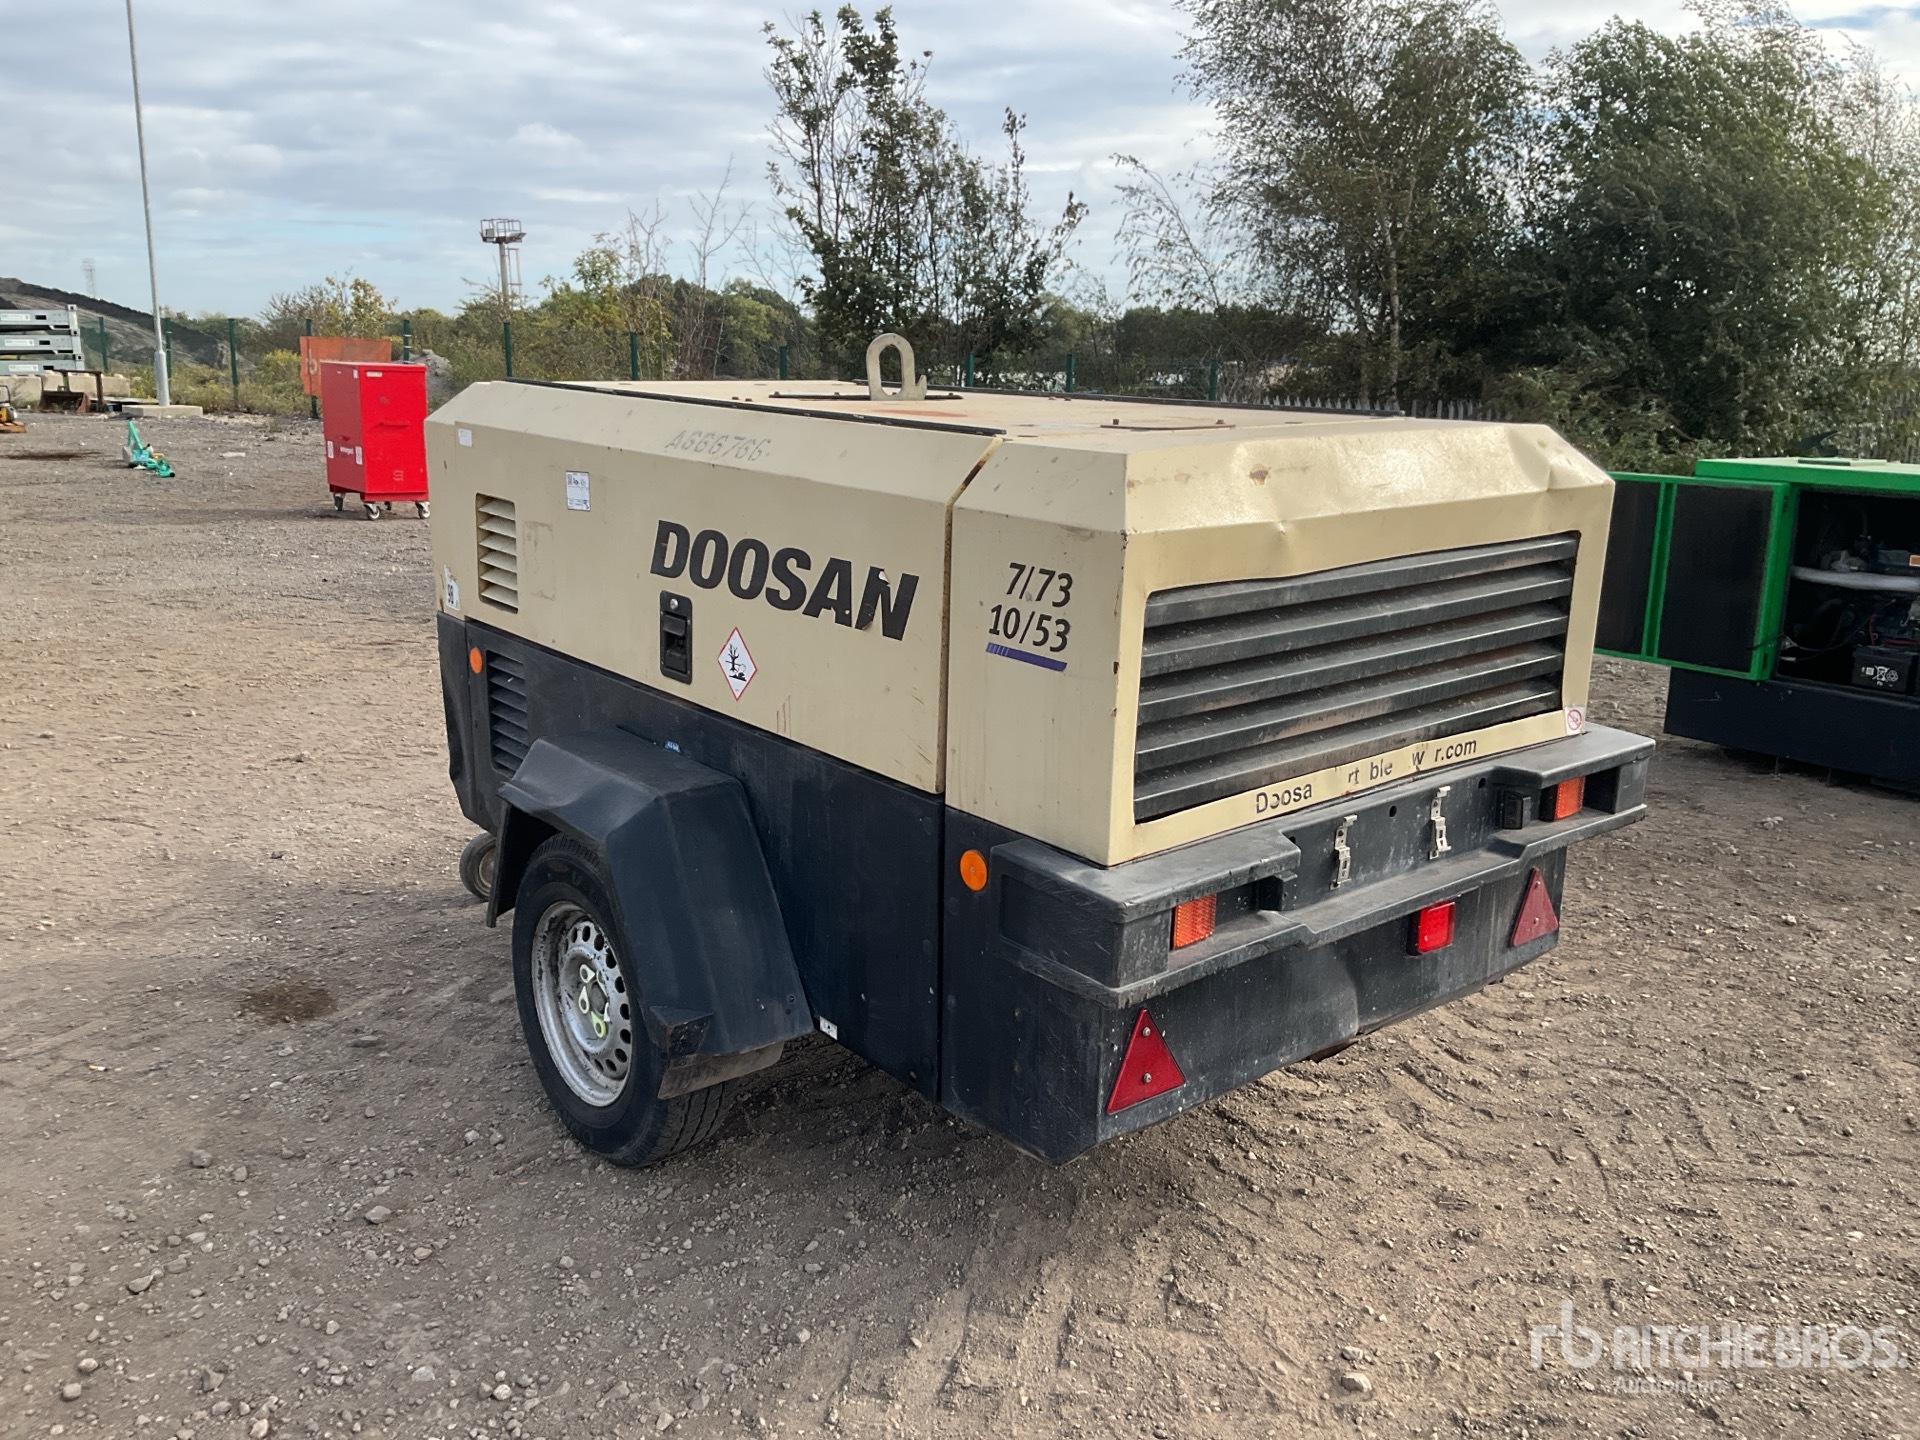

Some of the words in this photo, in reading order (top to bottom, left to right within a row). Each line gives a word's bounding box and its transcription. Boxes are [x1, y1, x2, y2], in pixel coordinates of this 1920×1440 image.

[650, 519, 920, 642] DOOSAN
[1006, 562, 1073, 608] 7/73
[988, 604, 1071, 653] 10/53
